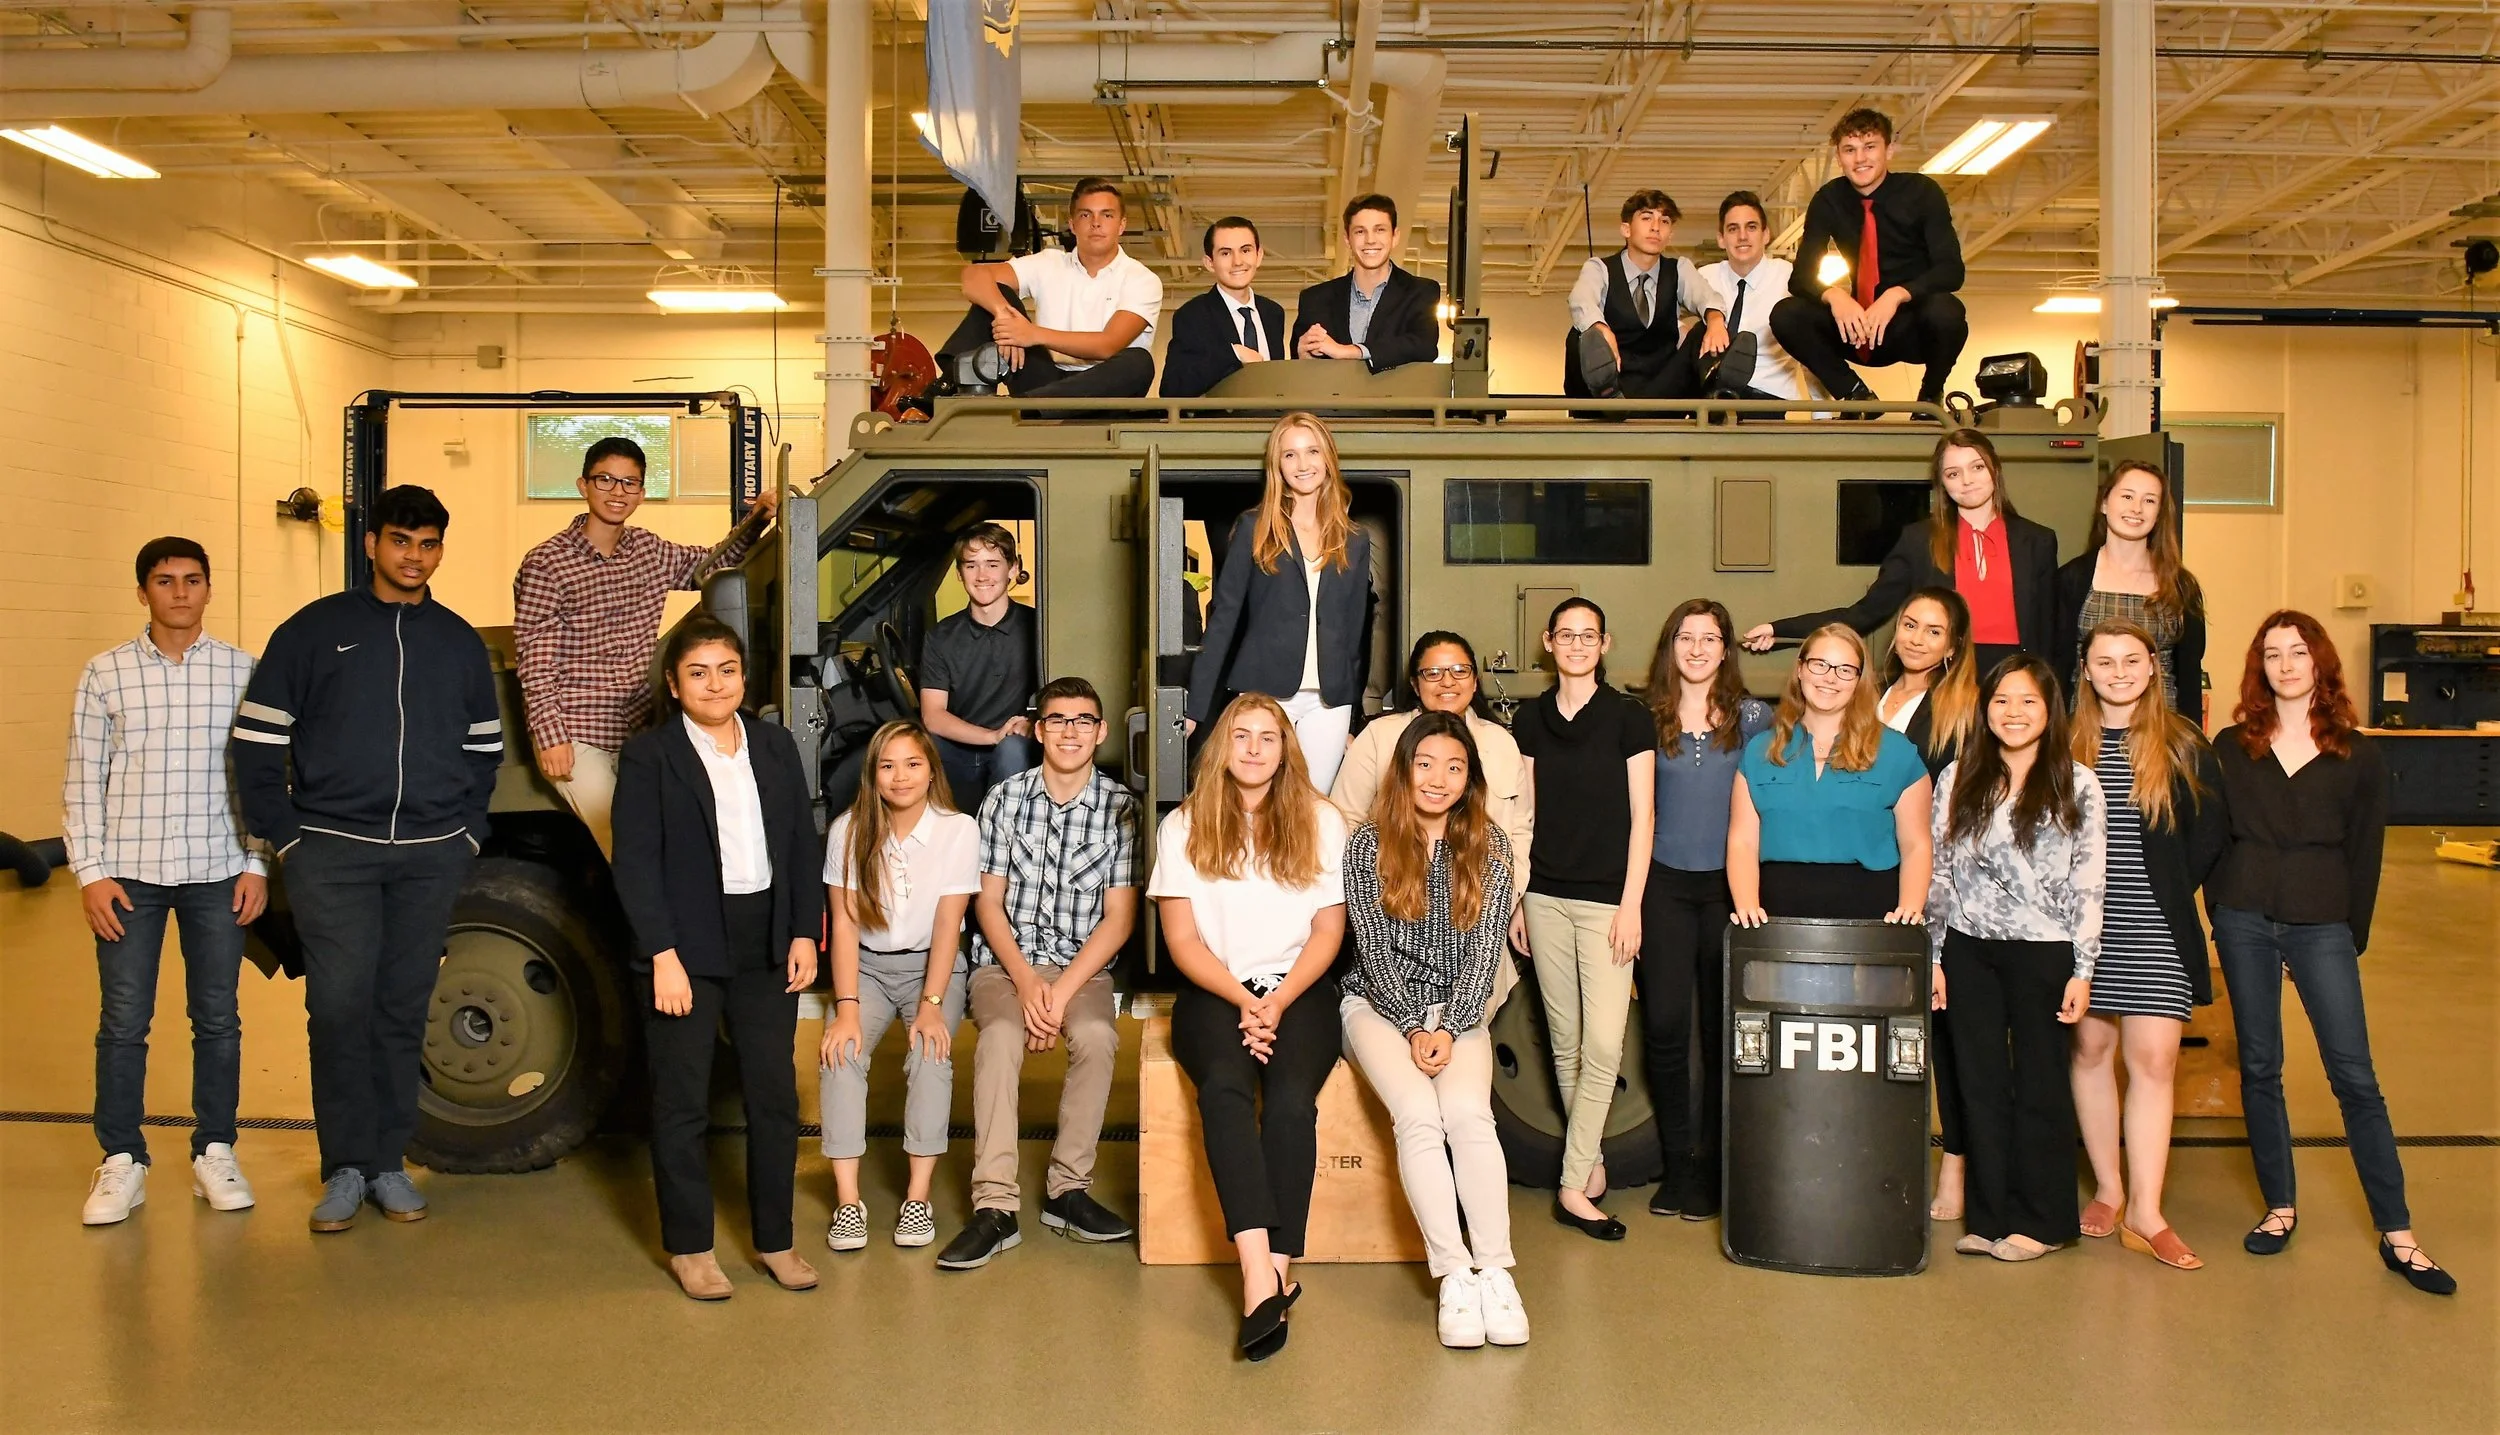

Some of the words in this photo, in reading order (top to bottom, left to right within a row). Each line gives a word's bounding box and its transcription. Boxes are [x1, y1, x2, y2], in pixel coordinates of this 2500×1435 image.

[346, 407, 355, 437] LIFT
[744, 407, 757, 438] LIFT
[345, 441, 354, 496] ROTARY
[744, 440, 757, 497] ROTARY
[1780, 1021, 1877, 1073] FBI
[1316, 1155, 1363, 1169] STER
